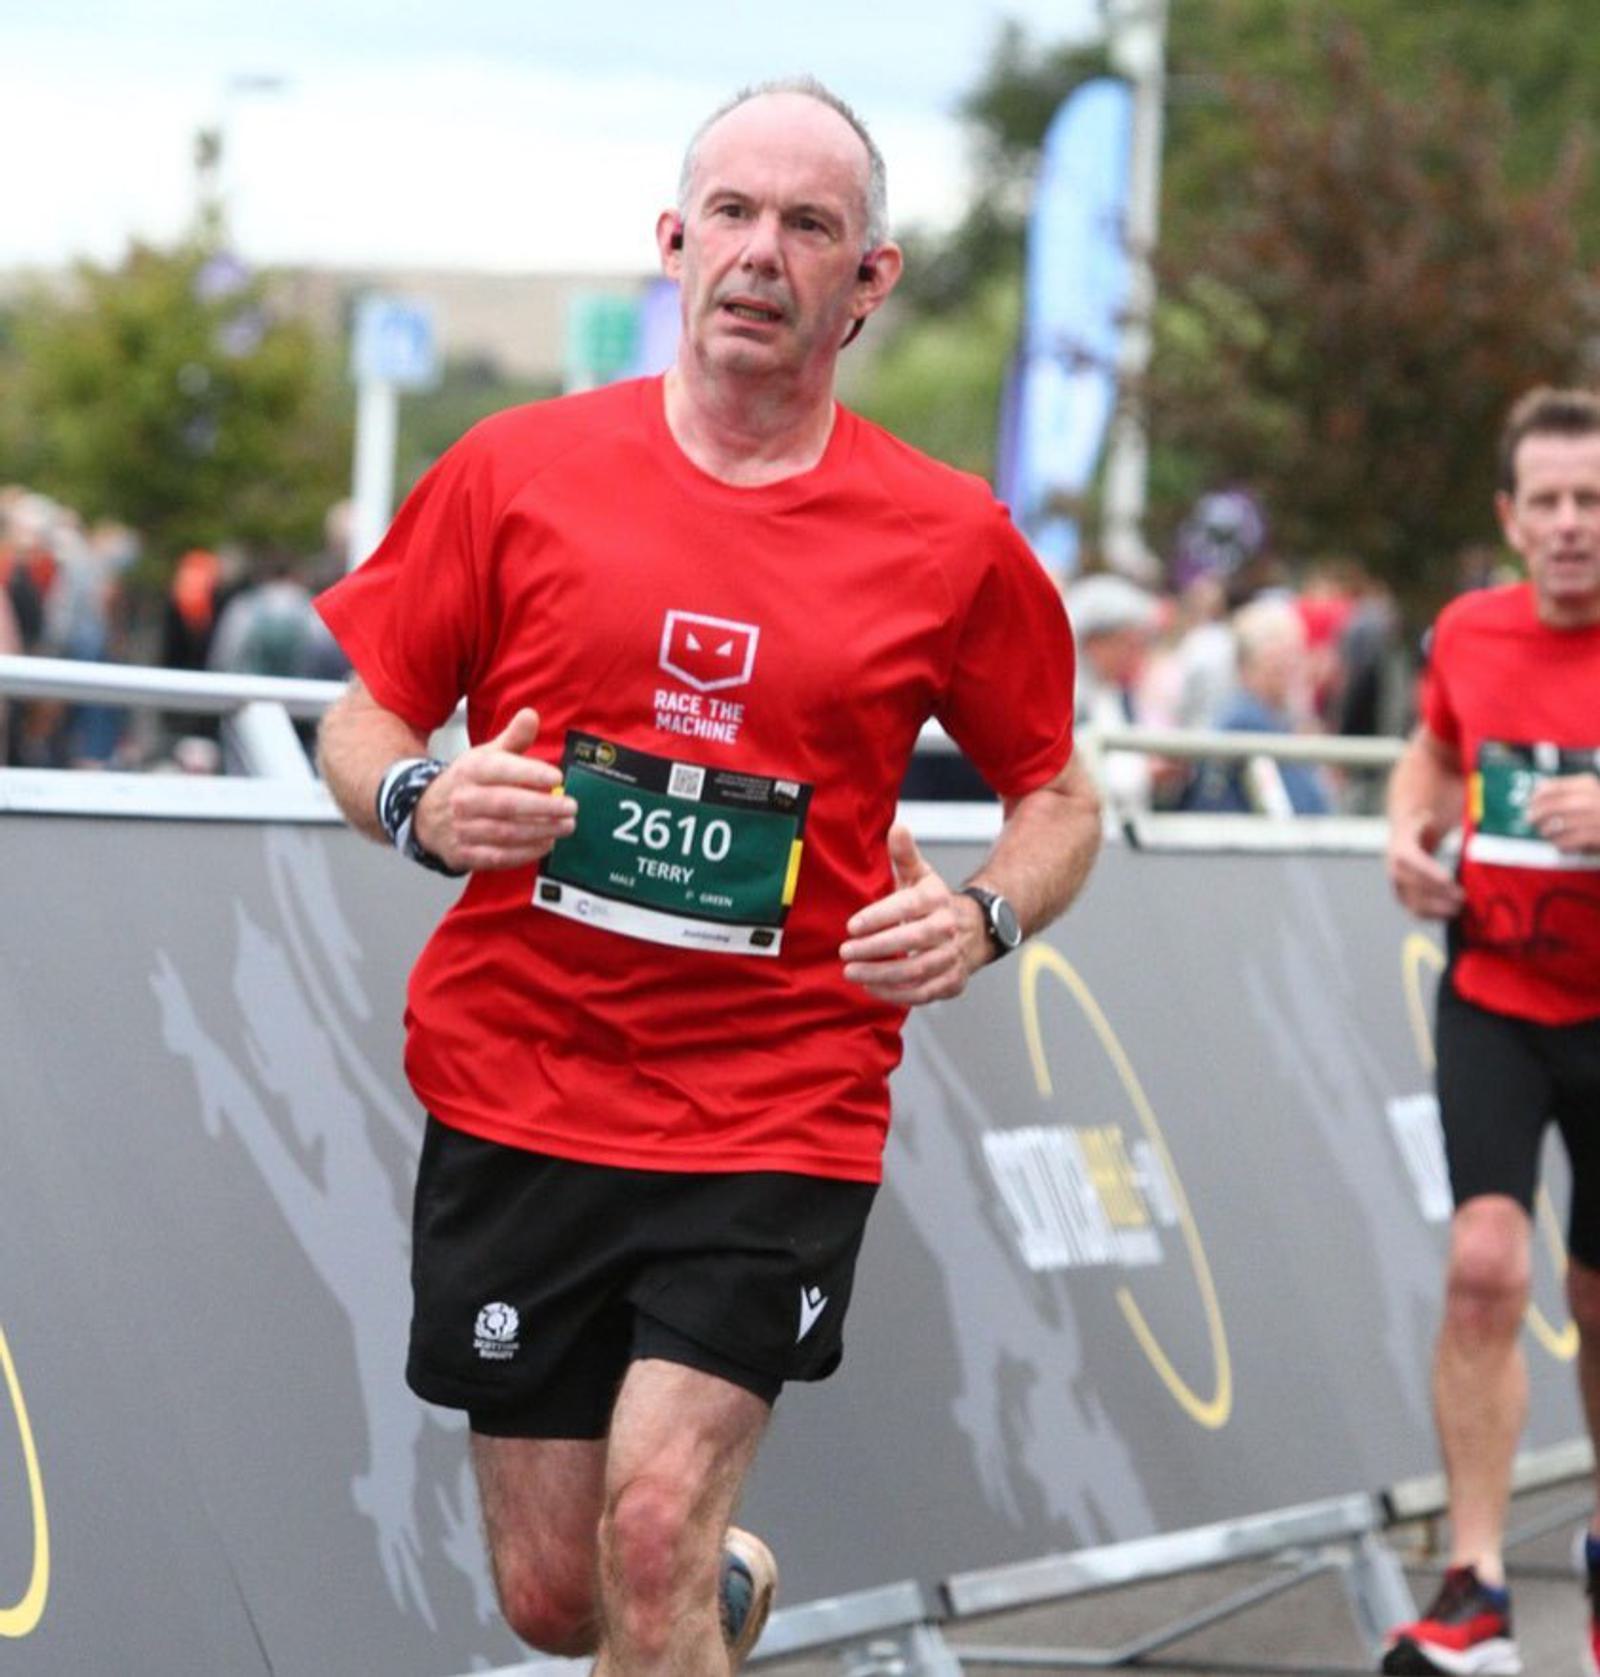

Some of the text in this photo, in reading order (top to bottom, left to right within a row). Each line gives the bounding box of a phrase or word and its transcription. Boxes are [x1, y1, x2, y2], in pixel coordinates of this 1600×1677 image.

[654, 690, 745, 724] RACE THE
[655, 711, 738, 745] MACHINE
[612, 799, 732, 862] 2610
[609, 871, 636, 888] MALE
[637, 856, 695, 886] TERRY
[699, 892, 733, 908] GREEN
